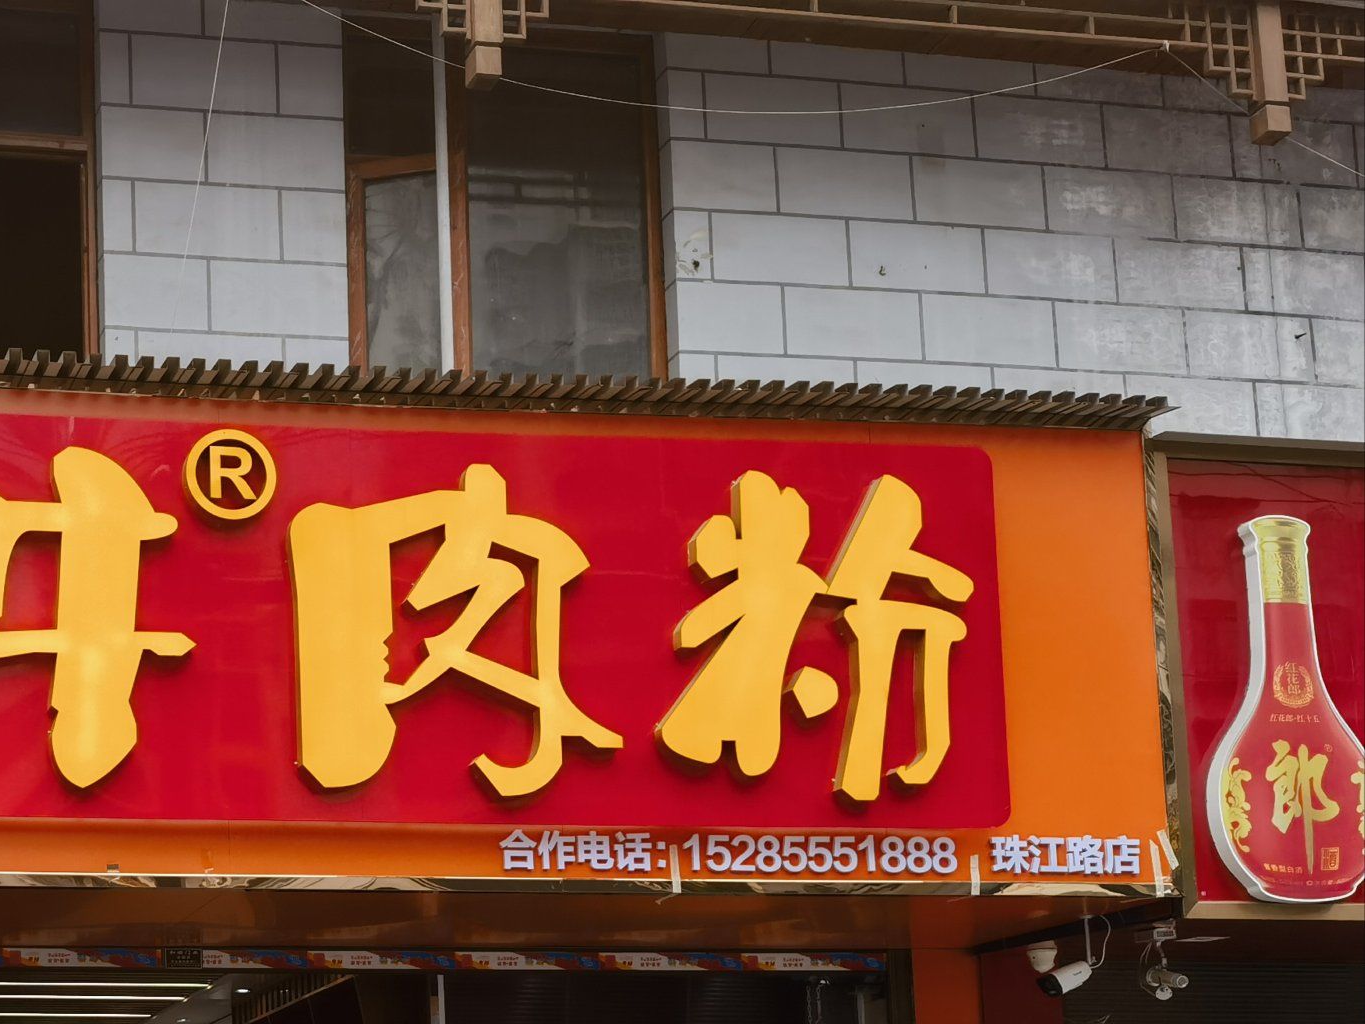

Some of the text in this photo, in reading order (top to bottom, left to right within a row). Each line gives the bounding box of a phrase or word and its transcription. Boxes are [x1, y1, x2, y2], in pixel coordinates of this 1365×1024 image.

[1265, 739, 1340, 875] 郎
[682, 832, 958, 874] 15285551888
[990, 834, 1141, 875] 珠江路店
